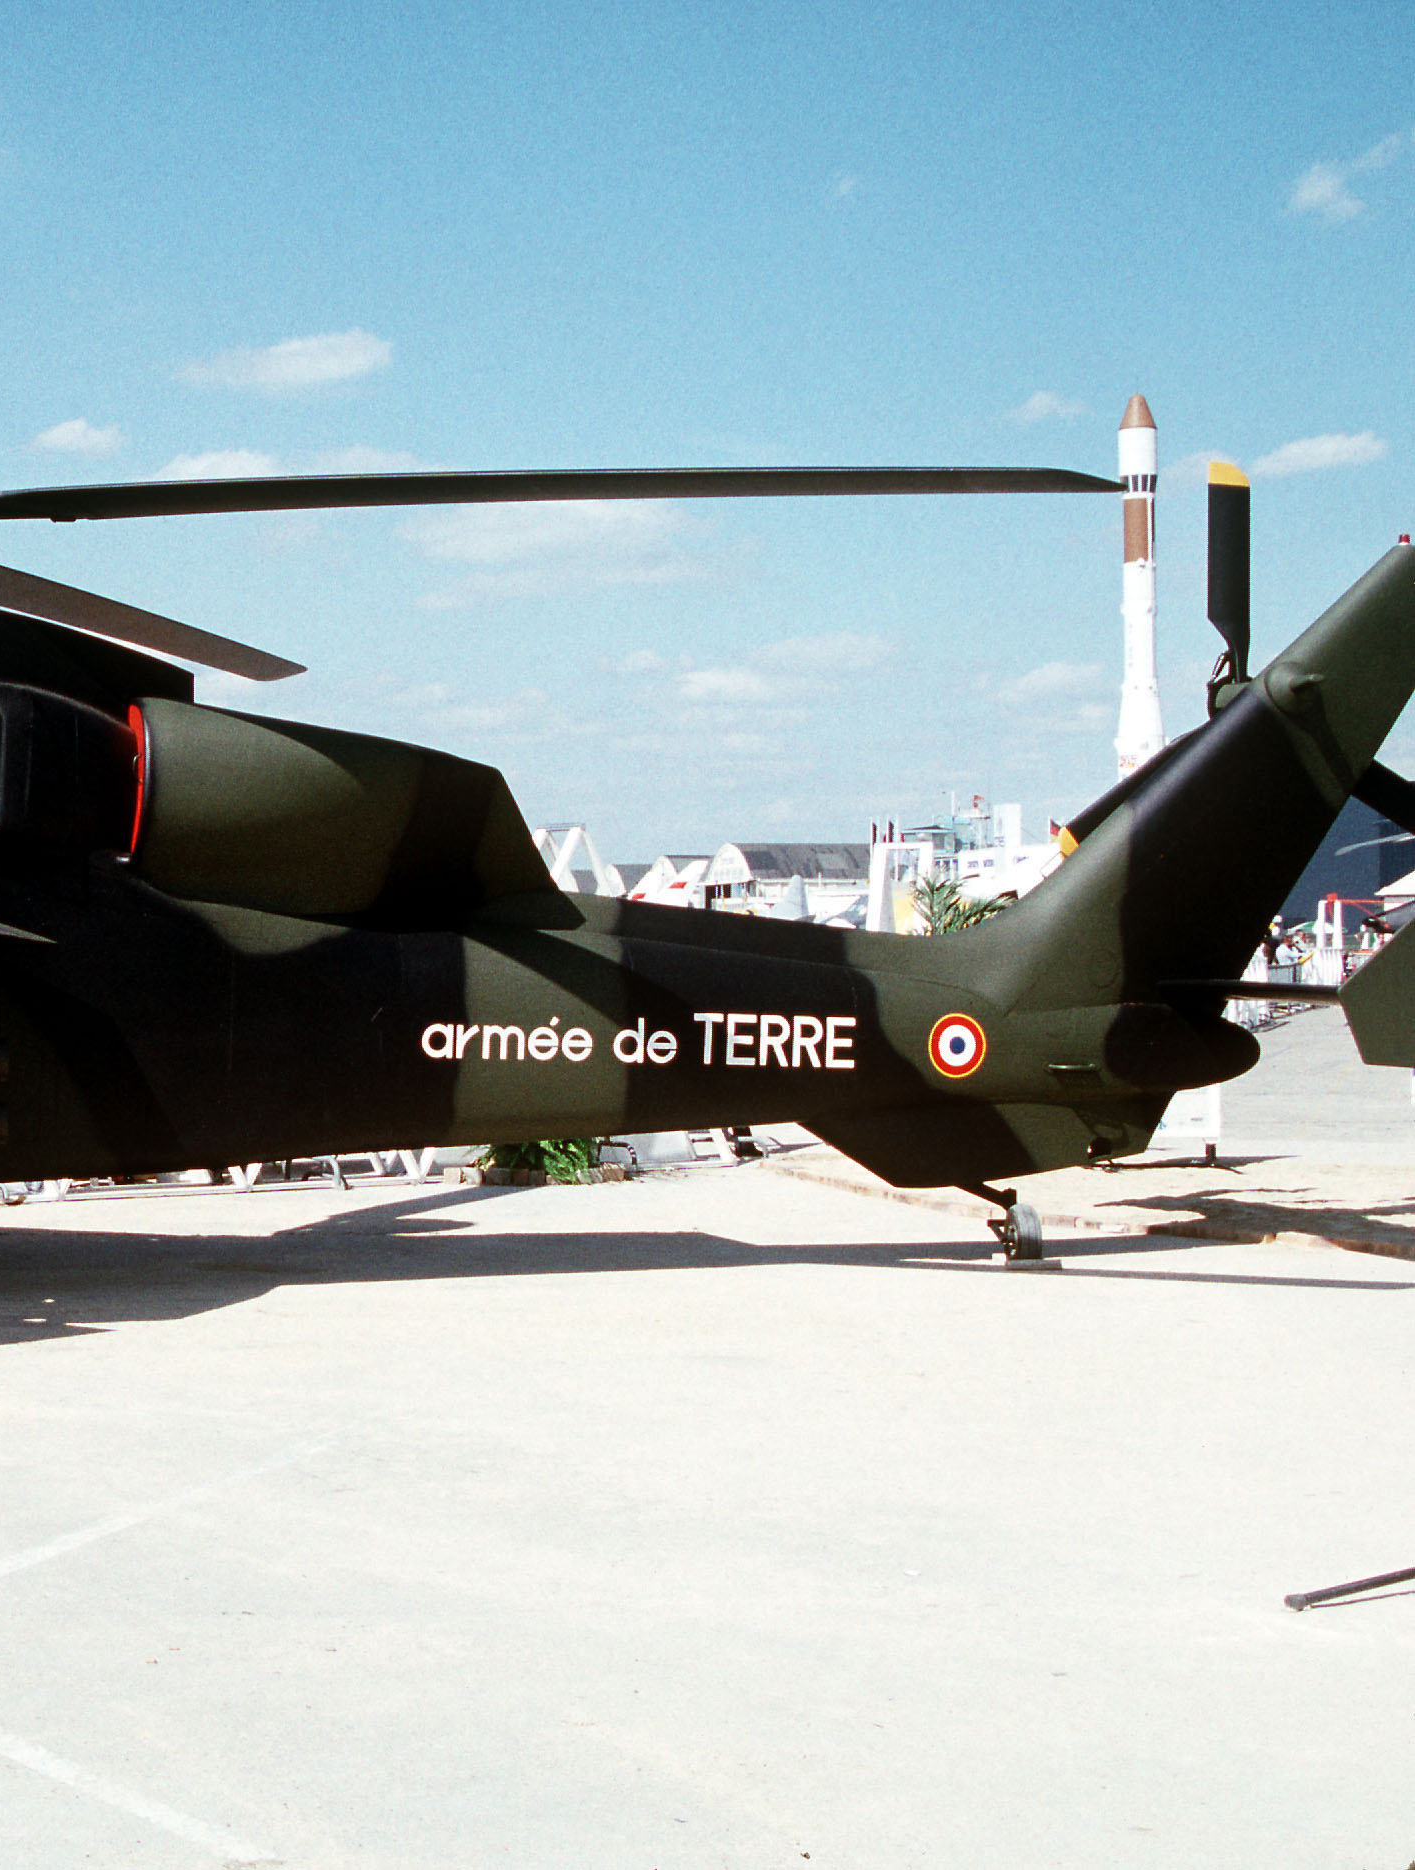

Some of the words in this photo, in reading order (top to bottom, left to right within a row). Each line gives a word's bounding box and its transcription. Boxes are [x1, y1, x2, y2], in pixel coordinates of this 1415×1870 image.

[421, 1016, 593, 1062] armée
[612, 1017, 677, 1064] de
[693, 1012, 857, 1069] TERRE
